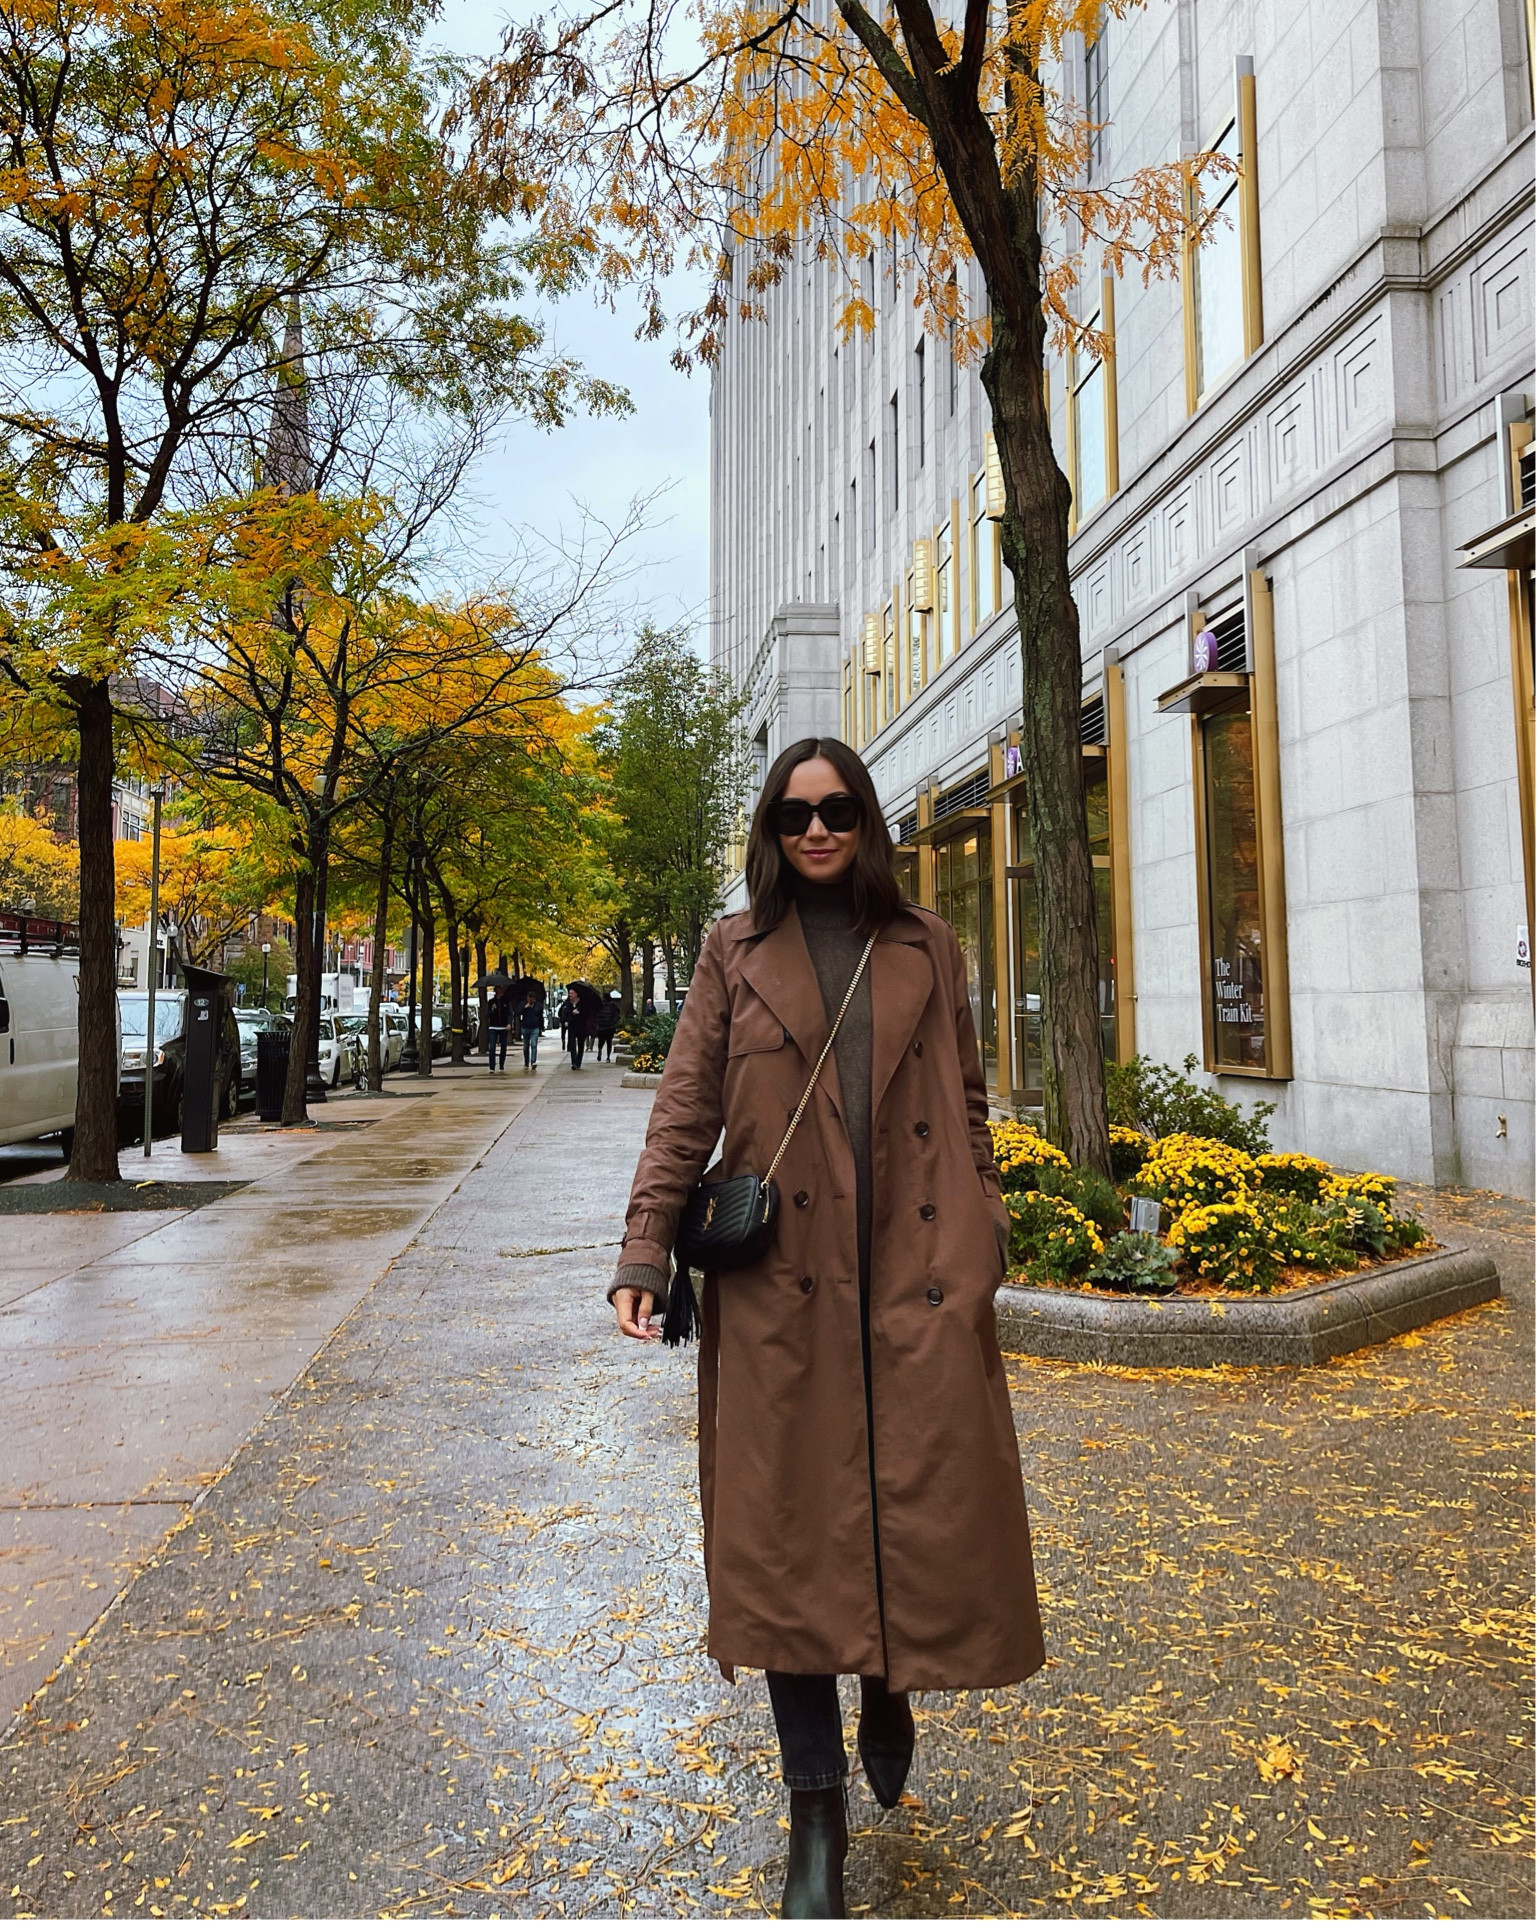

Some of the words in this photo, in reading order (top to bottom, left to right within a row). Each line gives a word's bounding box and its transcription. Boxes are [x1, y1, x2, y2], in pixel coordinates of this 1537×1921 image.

[1215, 957, 1230, 977] The
[1215, 980, 1243, 999] Winter
[1216, 1002, 1239, 1022] Train
[1240, 1002, 1253, 1023] Kit
